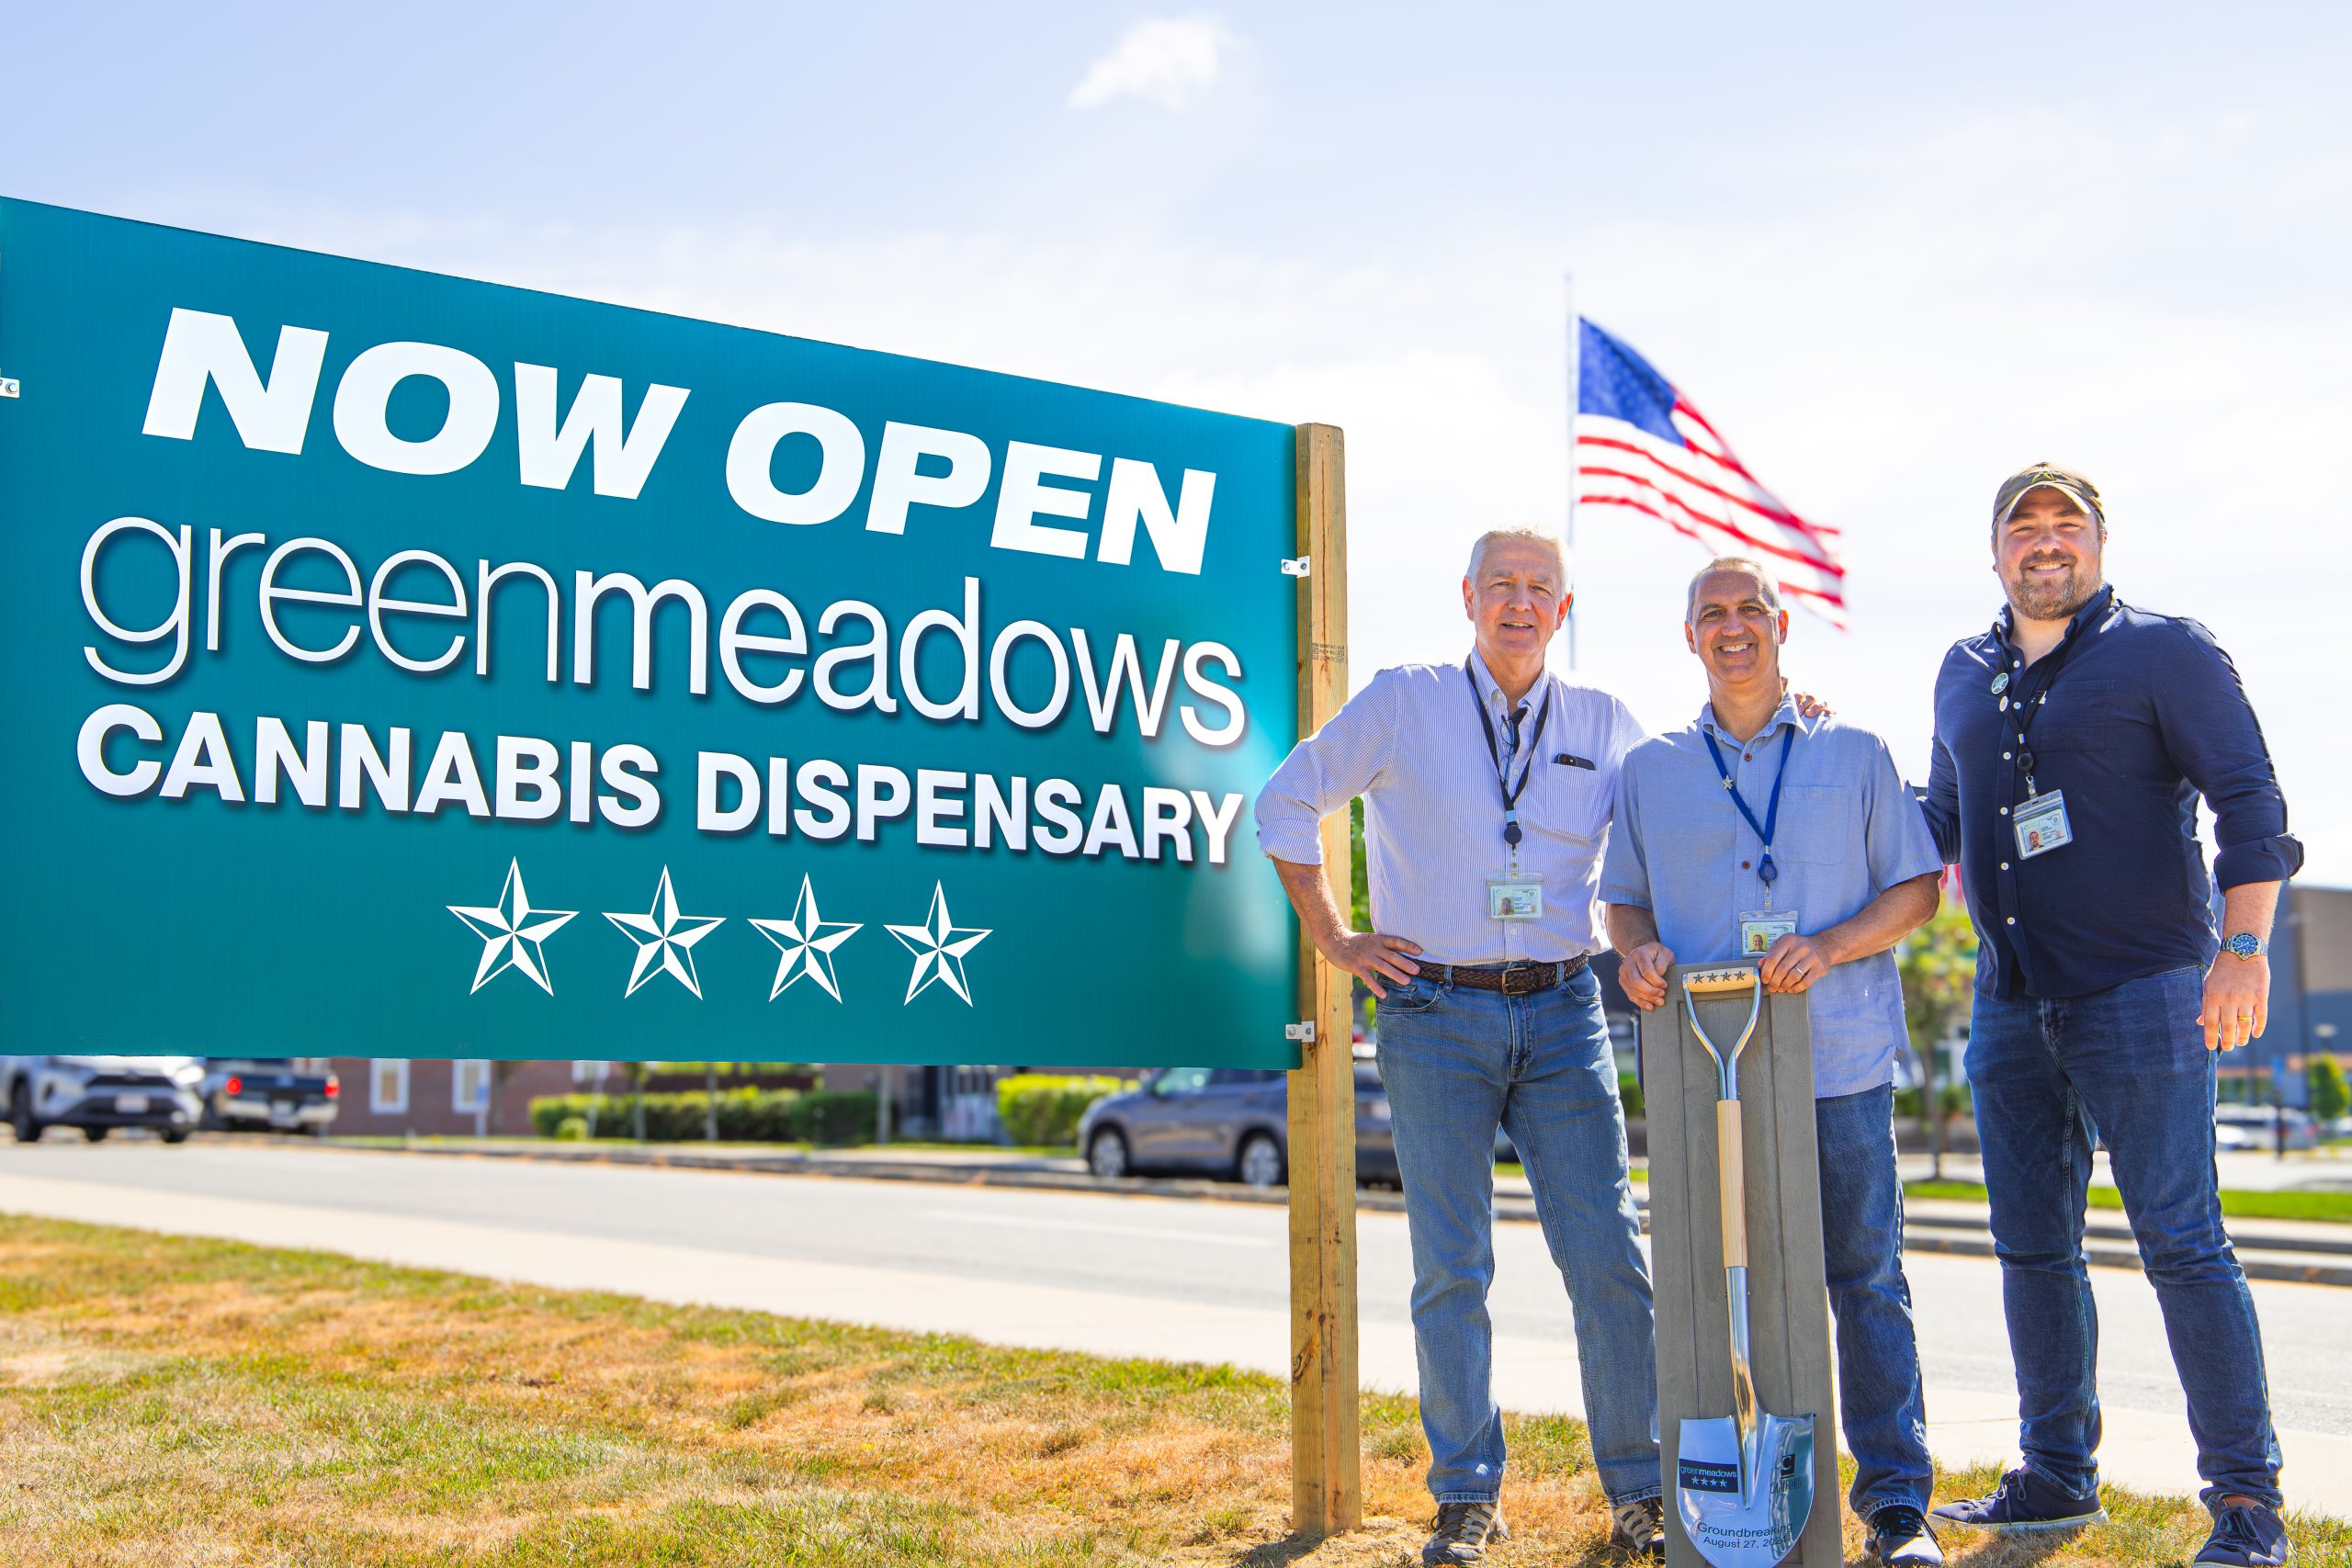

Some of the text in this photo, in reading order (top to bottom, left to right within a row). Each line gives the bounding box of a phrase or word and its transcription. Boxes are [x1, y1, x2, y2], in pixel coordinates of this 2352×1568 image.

[142, 308, 1216, 575] NOW OPEN
[80, 517, 1245, 747] greenmeadows
[77, 705, 1244, 863] CANNABIS DISPENSARY
[1680, 1466, 1736, 1478] greenmeadows
[1697, 1522, 1793, 1538] Groundbreaking
[1702, 1535, 1787, 1549] August 27, 2024
